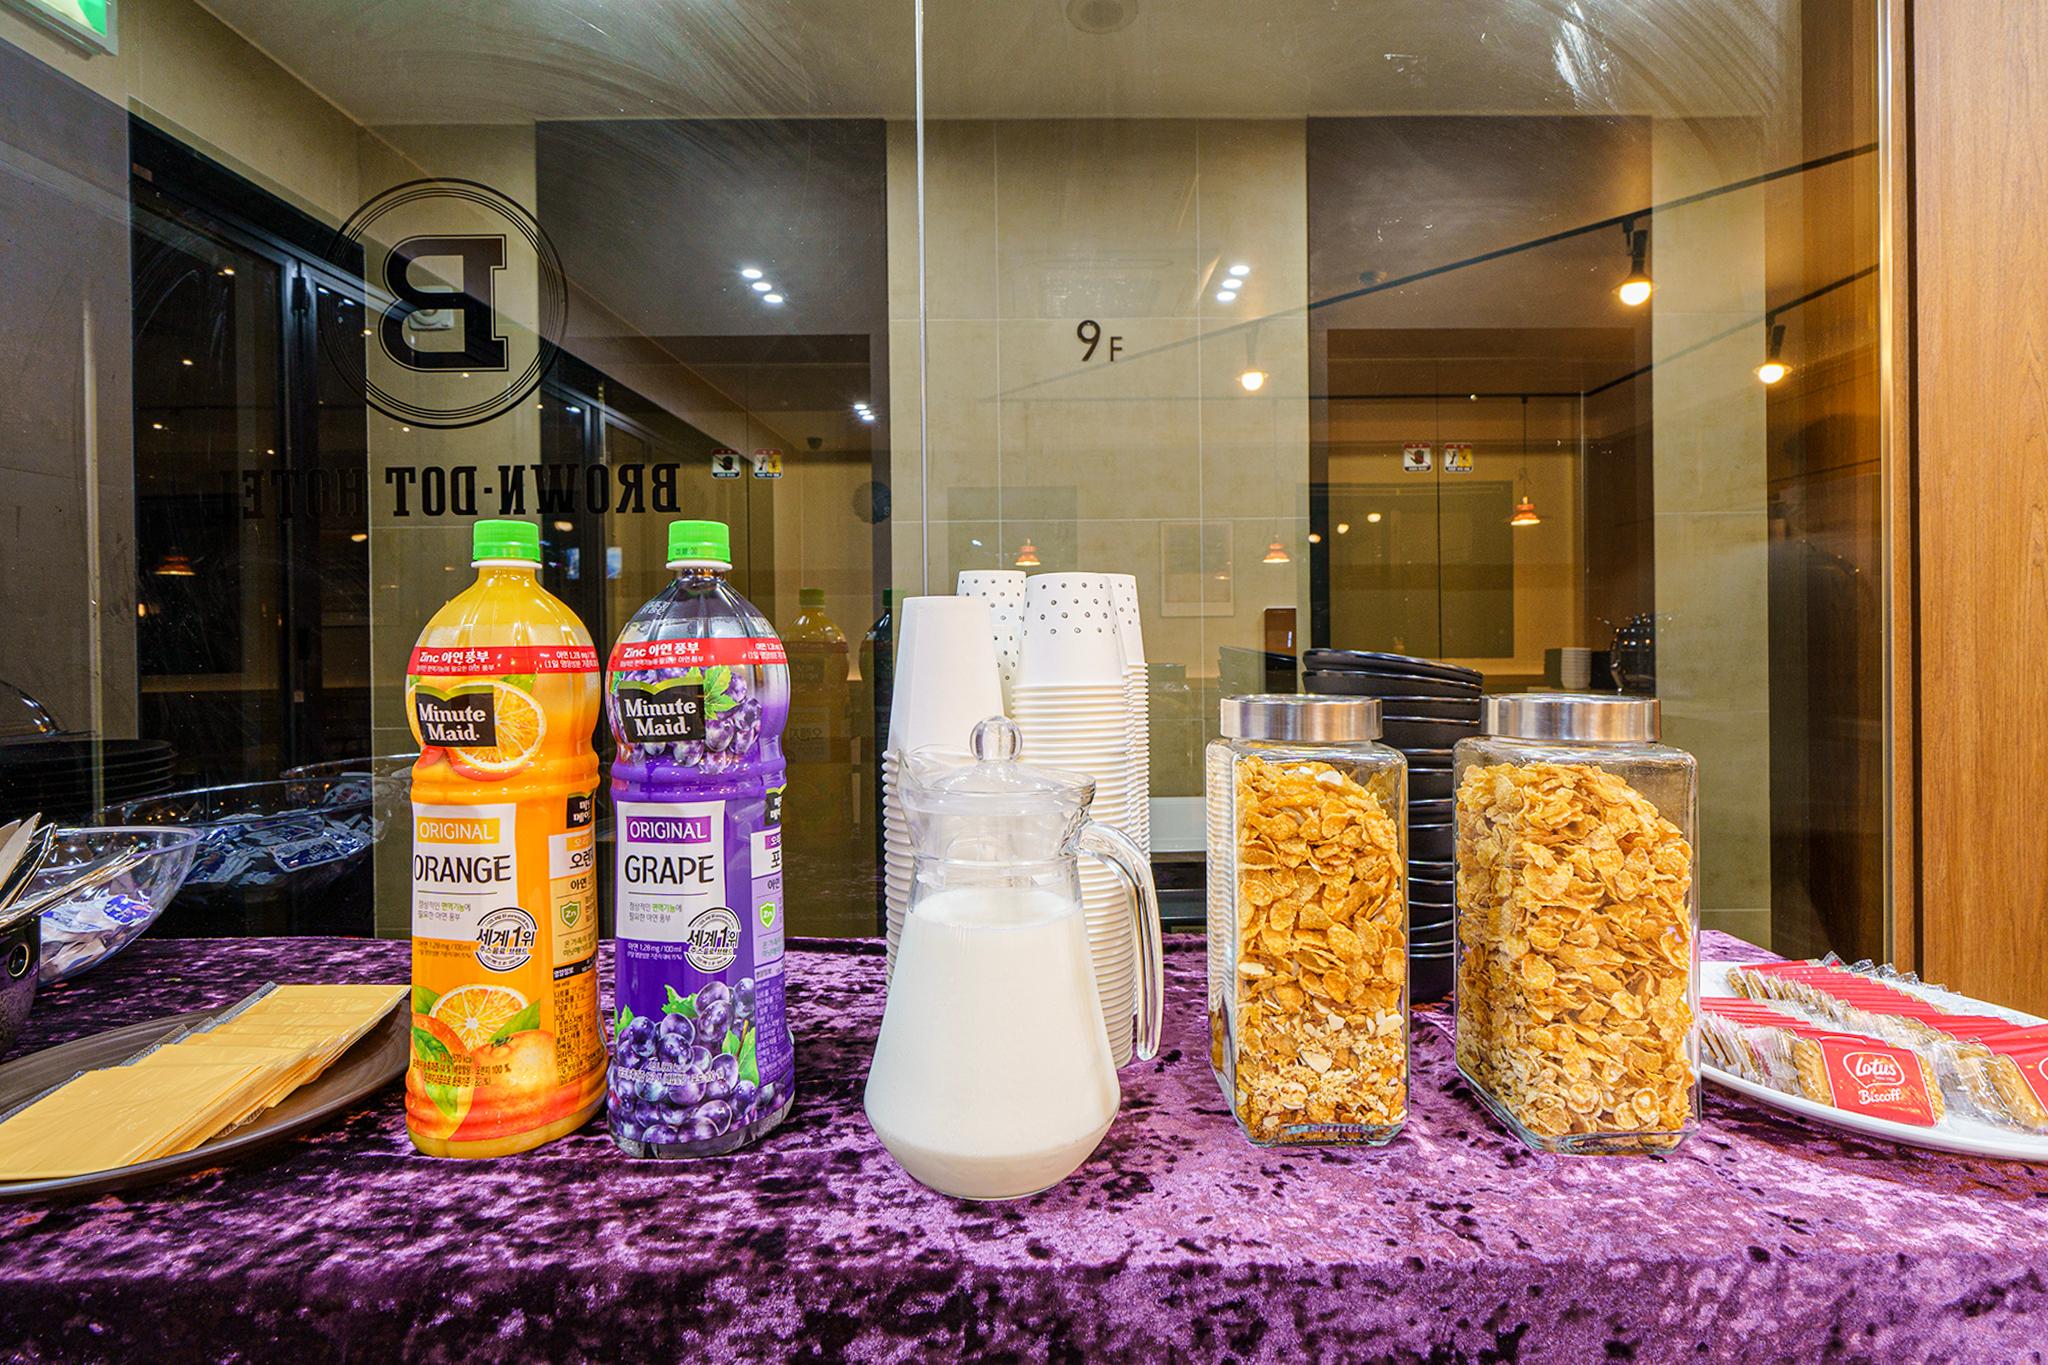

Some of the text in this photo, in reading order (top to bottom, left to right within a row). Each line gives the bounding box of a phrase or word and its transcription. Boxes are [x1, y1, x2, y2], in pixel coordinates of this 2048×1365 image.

[623, 642, 700, 658] Zinc 아연 풍부
[418, 703, 486, 722] Minute
[624, 698, 697, 717] Minute
[419, 821, 495, 840] ORIGINAL
[629, 821, 708, 839] ORIGINAL
[414, 854, 512, 884] ORANGE
[624, 854, 715, 885] GRAPE
[476, 925, 535, 947] 세계 1위
[687, 926, 738, 948] 세계 1위
[1855, 1056, 1897, 1077] Lotus
[1857, 1087, 1902, 1105] Biscoff
